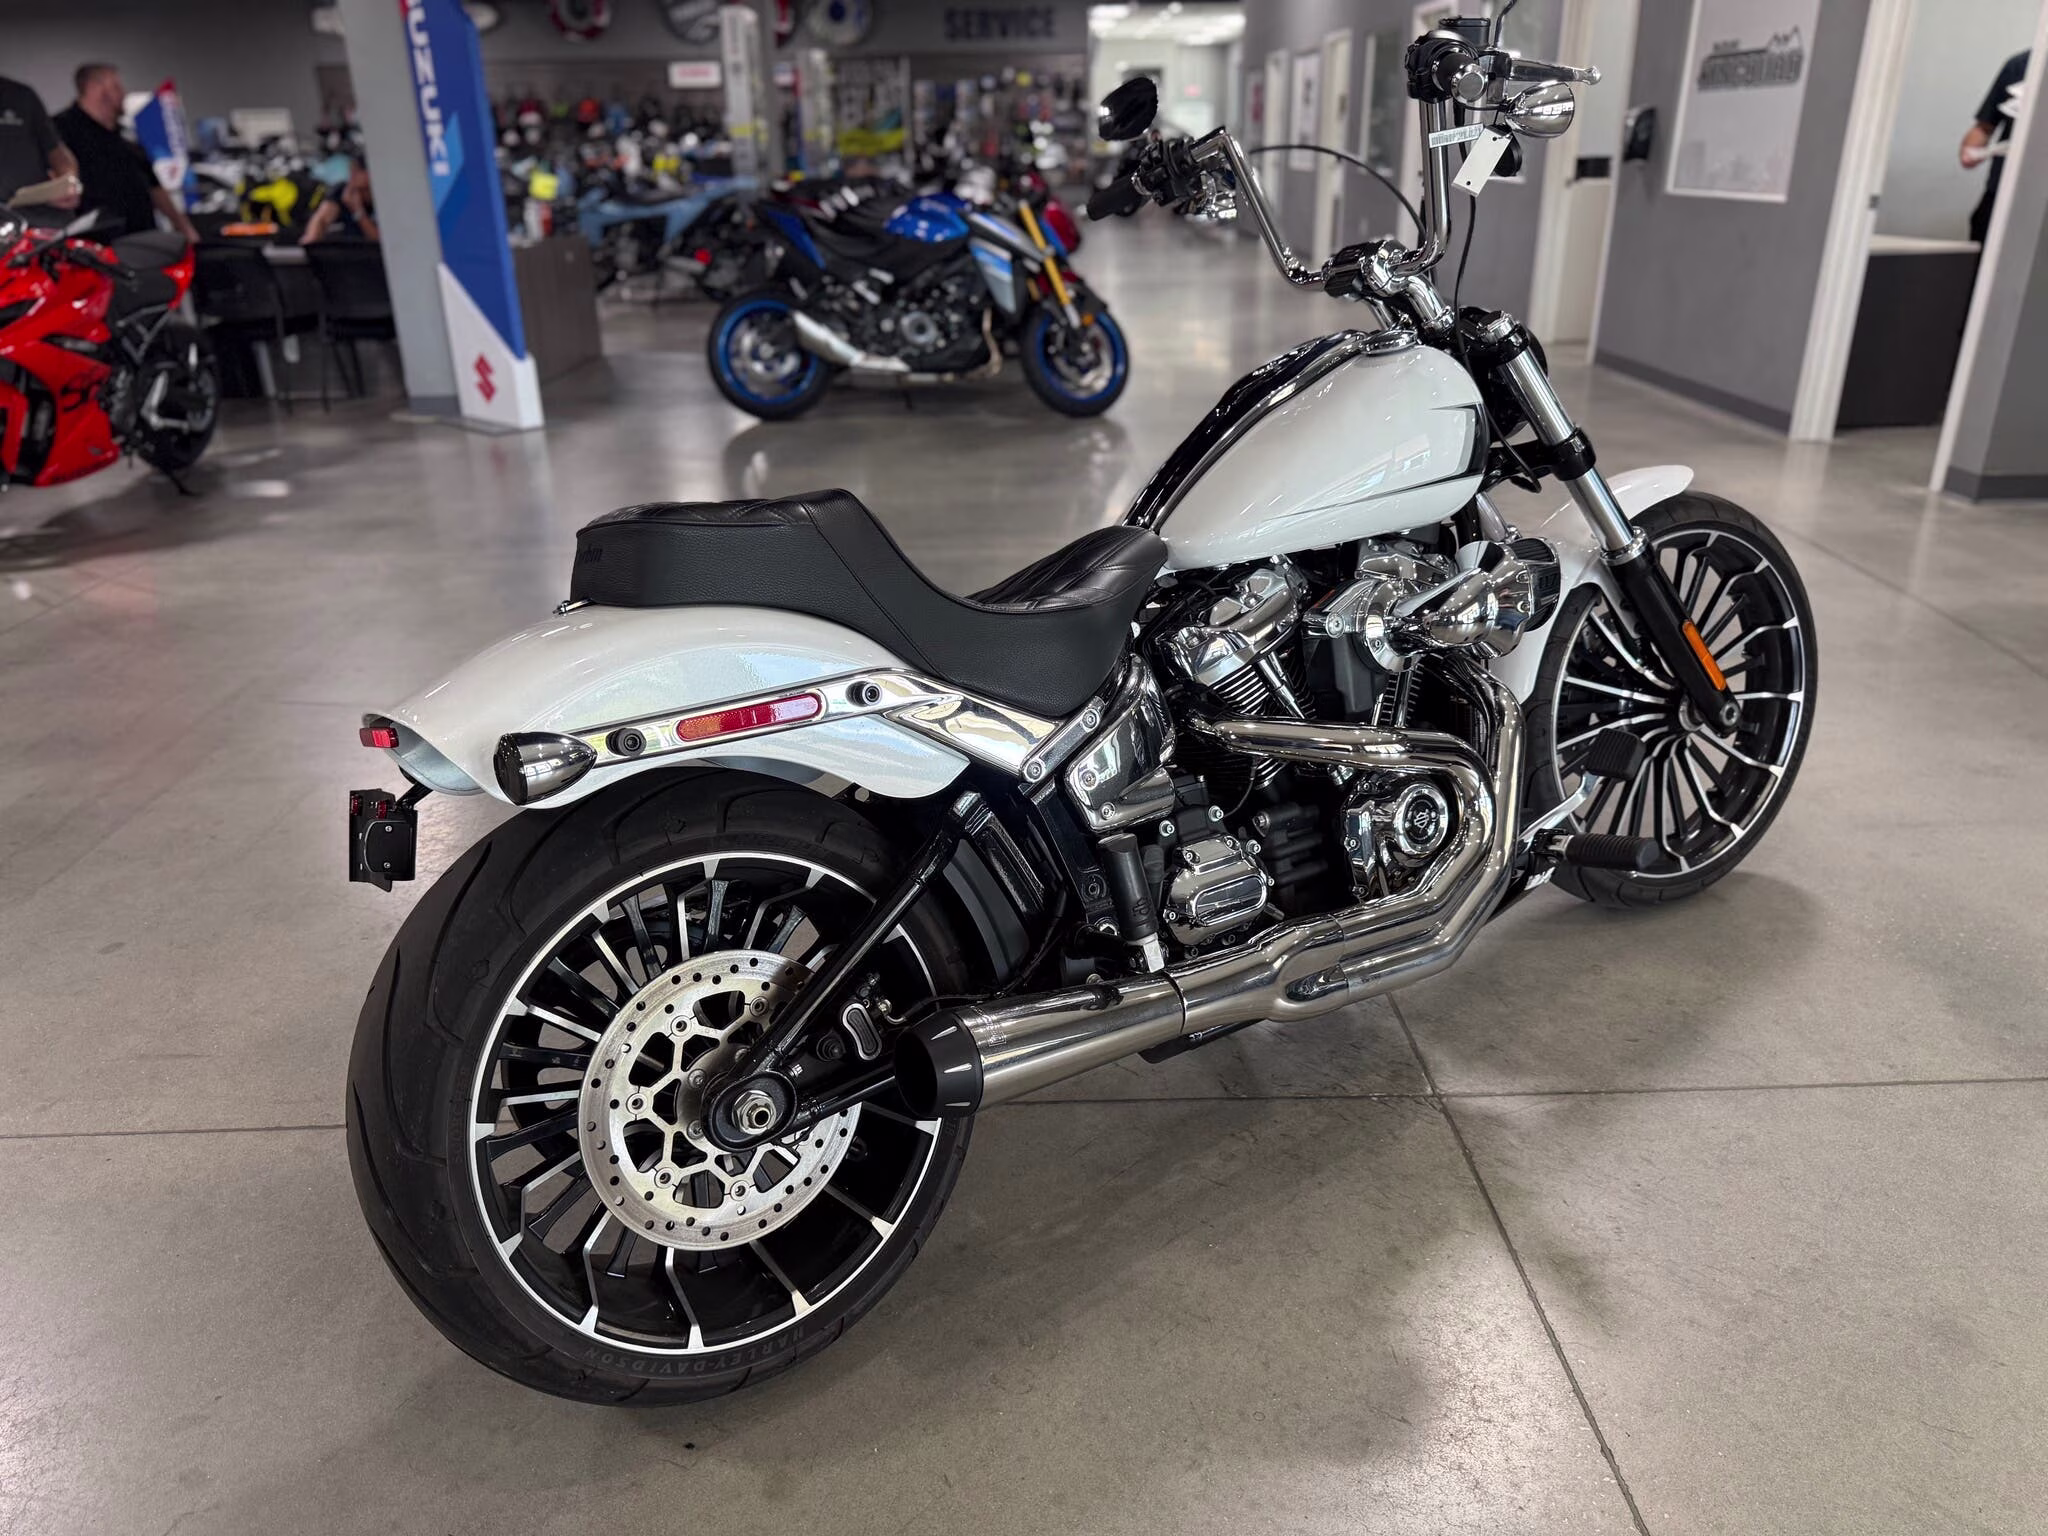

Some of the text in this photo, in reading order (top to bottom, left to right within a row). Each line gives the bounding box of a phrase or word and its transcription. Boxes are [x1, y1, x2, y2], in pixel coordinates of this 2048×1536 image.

[946, 8, 1055, 41] SERVICE
[406, 0, 450, 176] UZUKI
[583, 1326, 805, 1374] HARLEY-DAVIDSON
